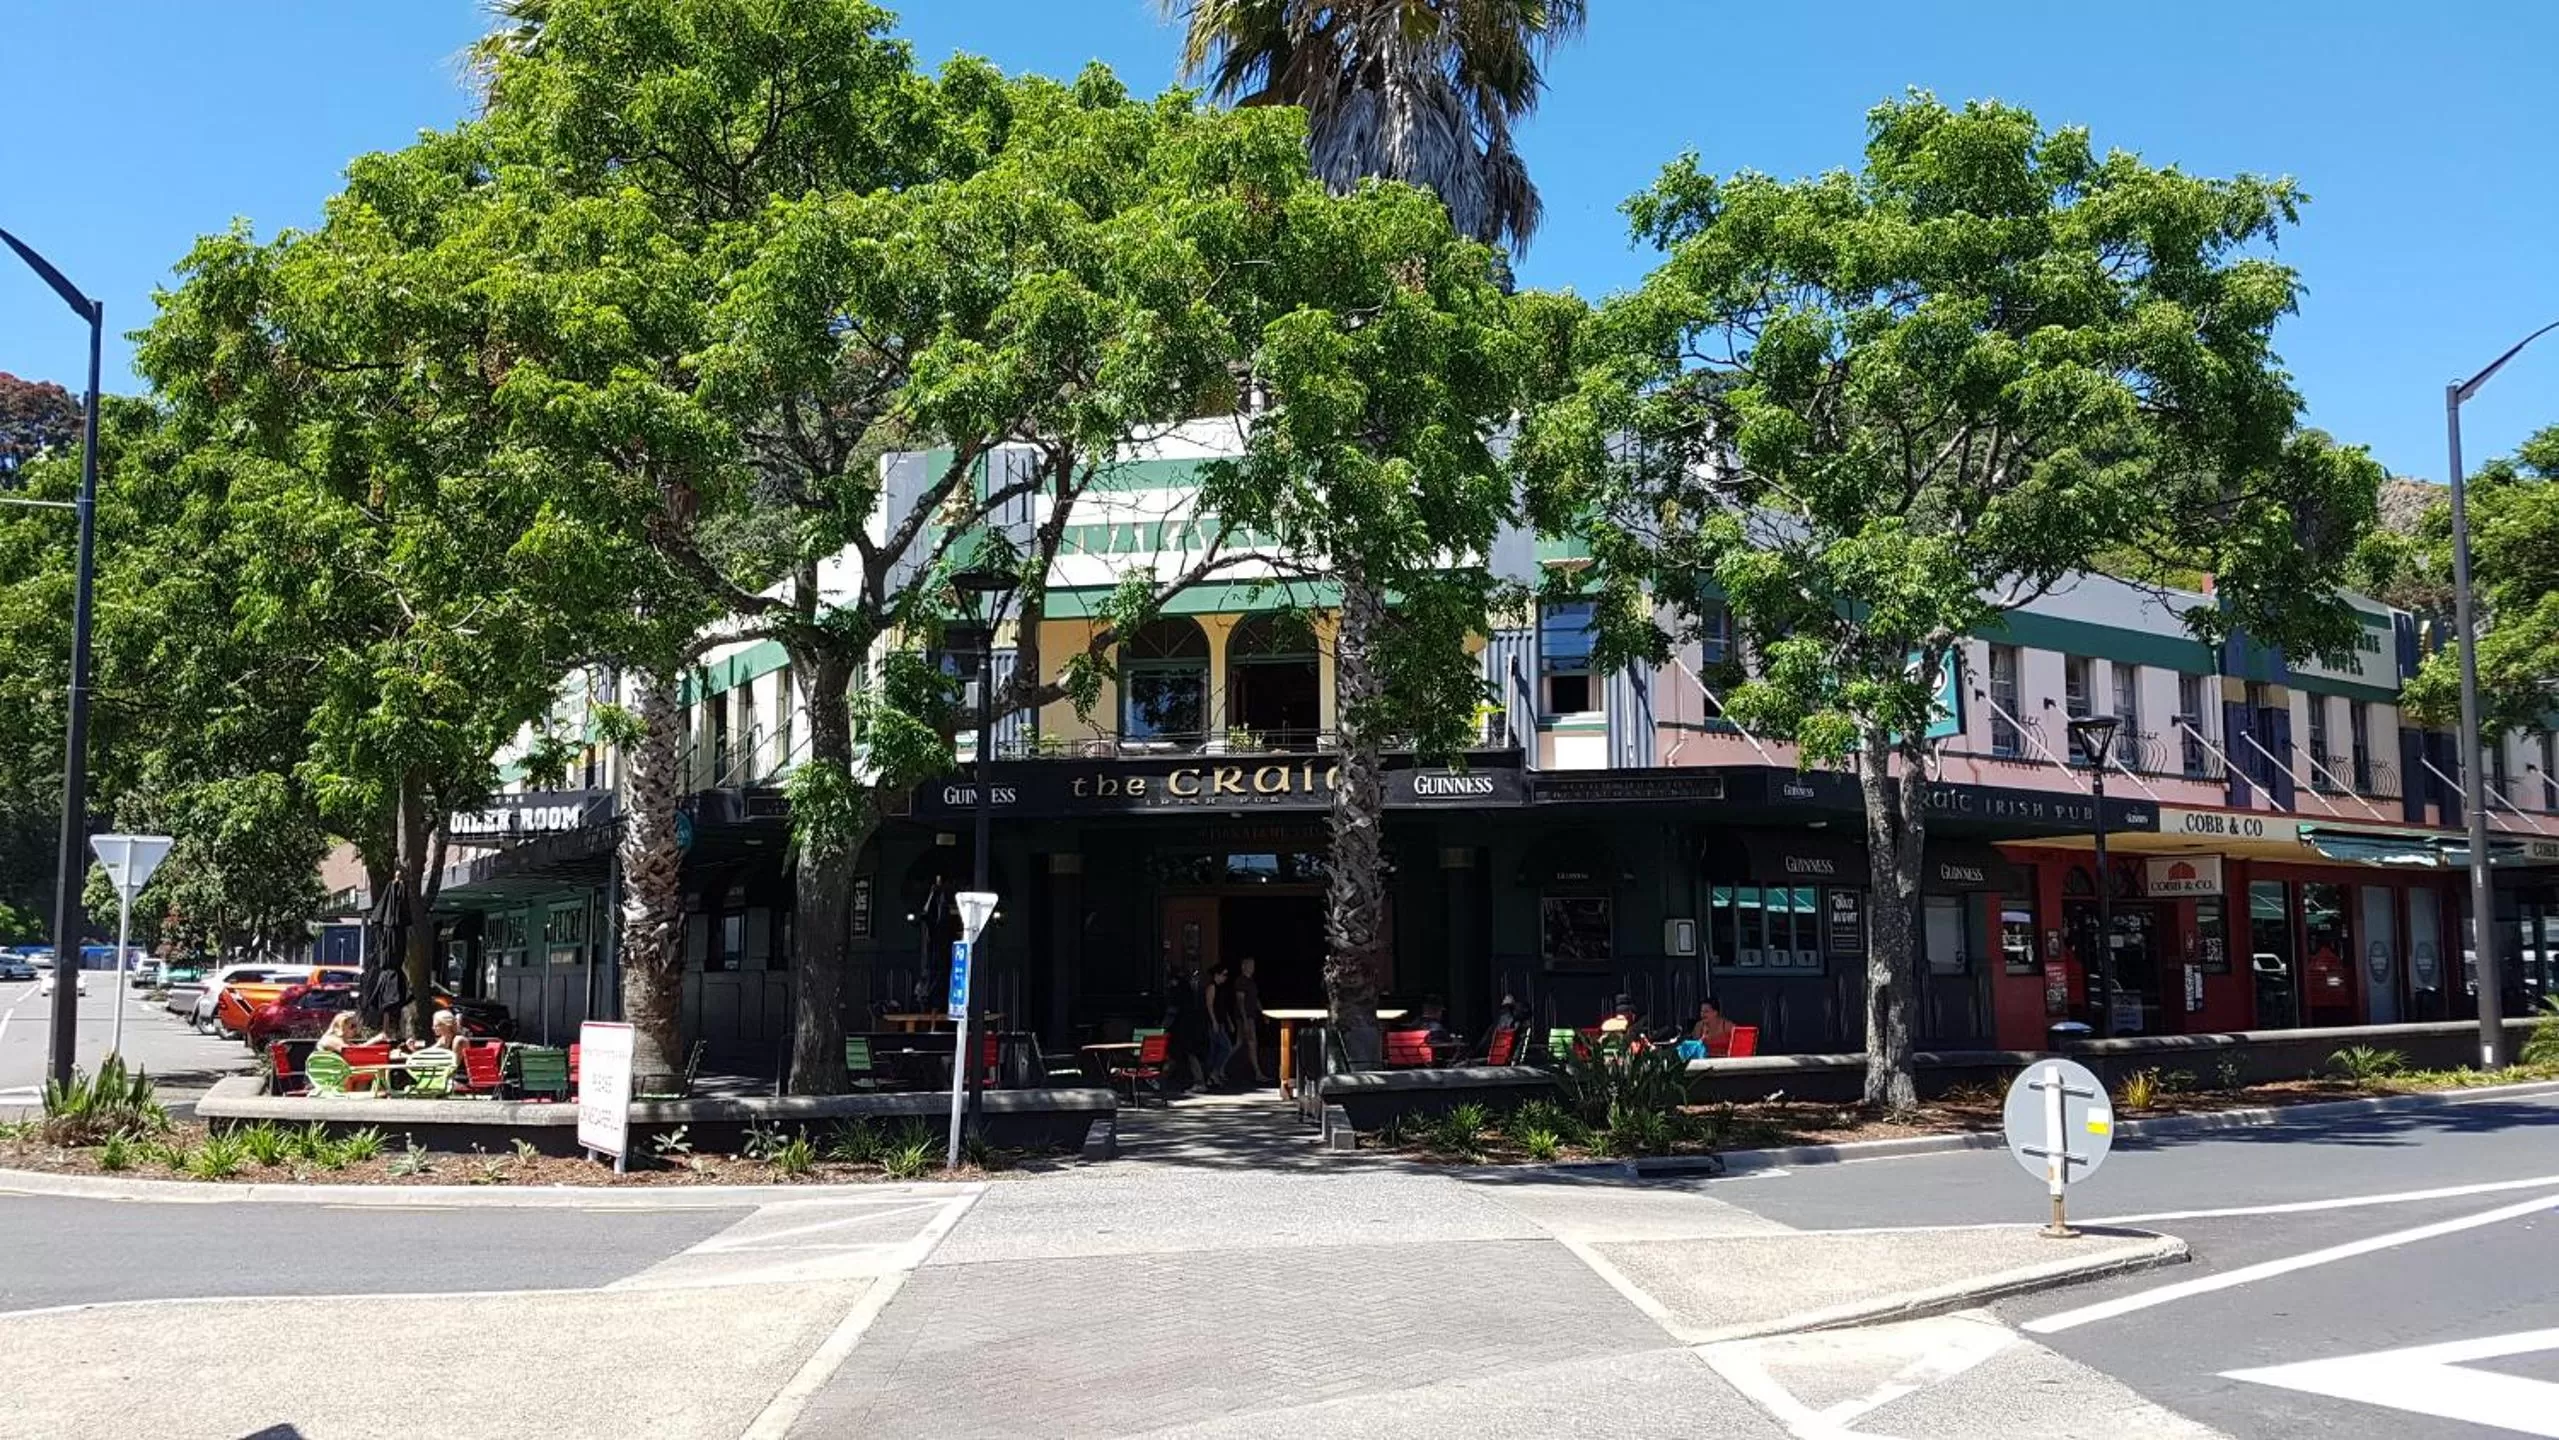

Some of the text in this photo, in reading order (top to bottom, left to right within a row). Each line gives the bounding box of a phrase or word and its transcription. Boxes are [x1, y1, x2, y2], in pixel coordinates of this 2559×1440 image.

[1071, 774, 1146, 797] the
[1414, 776, 1494, 794] GUINNESS
[1784, 784, 1815, 797] GUINNESS
[495, 796, 524, 804] THE
[943, 786, 1016, 804] GUINESS
[1985, 800, 2044, 817] IRISH
[2056, 805, 2093, 820] PUB
[450, 806, 581, 833] OILER ROOM
[2186, 813, 2263, 837] COBB & CO
[1785, 856, 1835, 873] GUINNESS
[1941, 863, 1984, 881] GUINNESS
[2151, 881, 2181, 891] COBB
[2184, 881, 2194, 890] &
